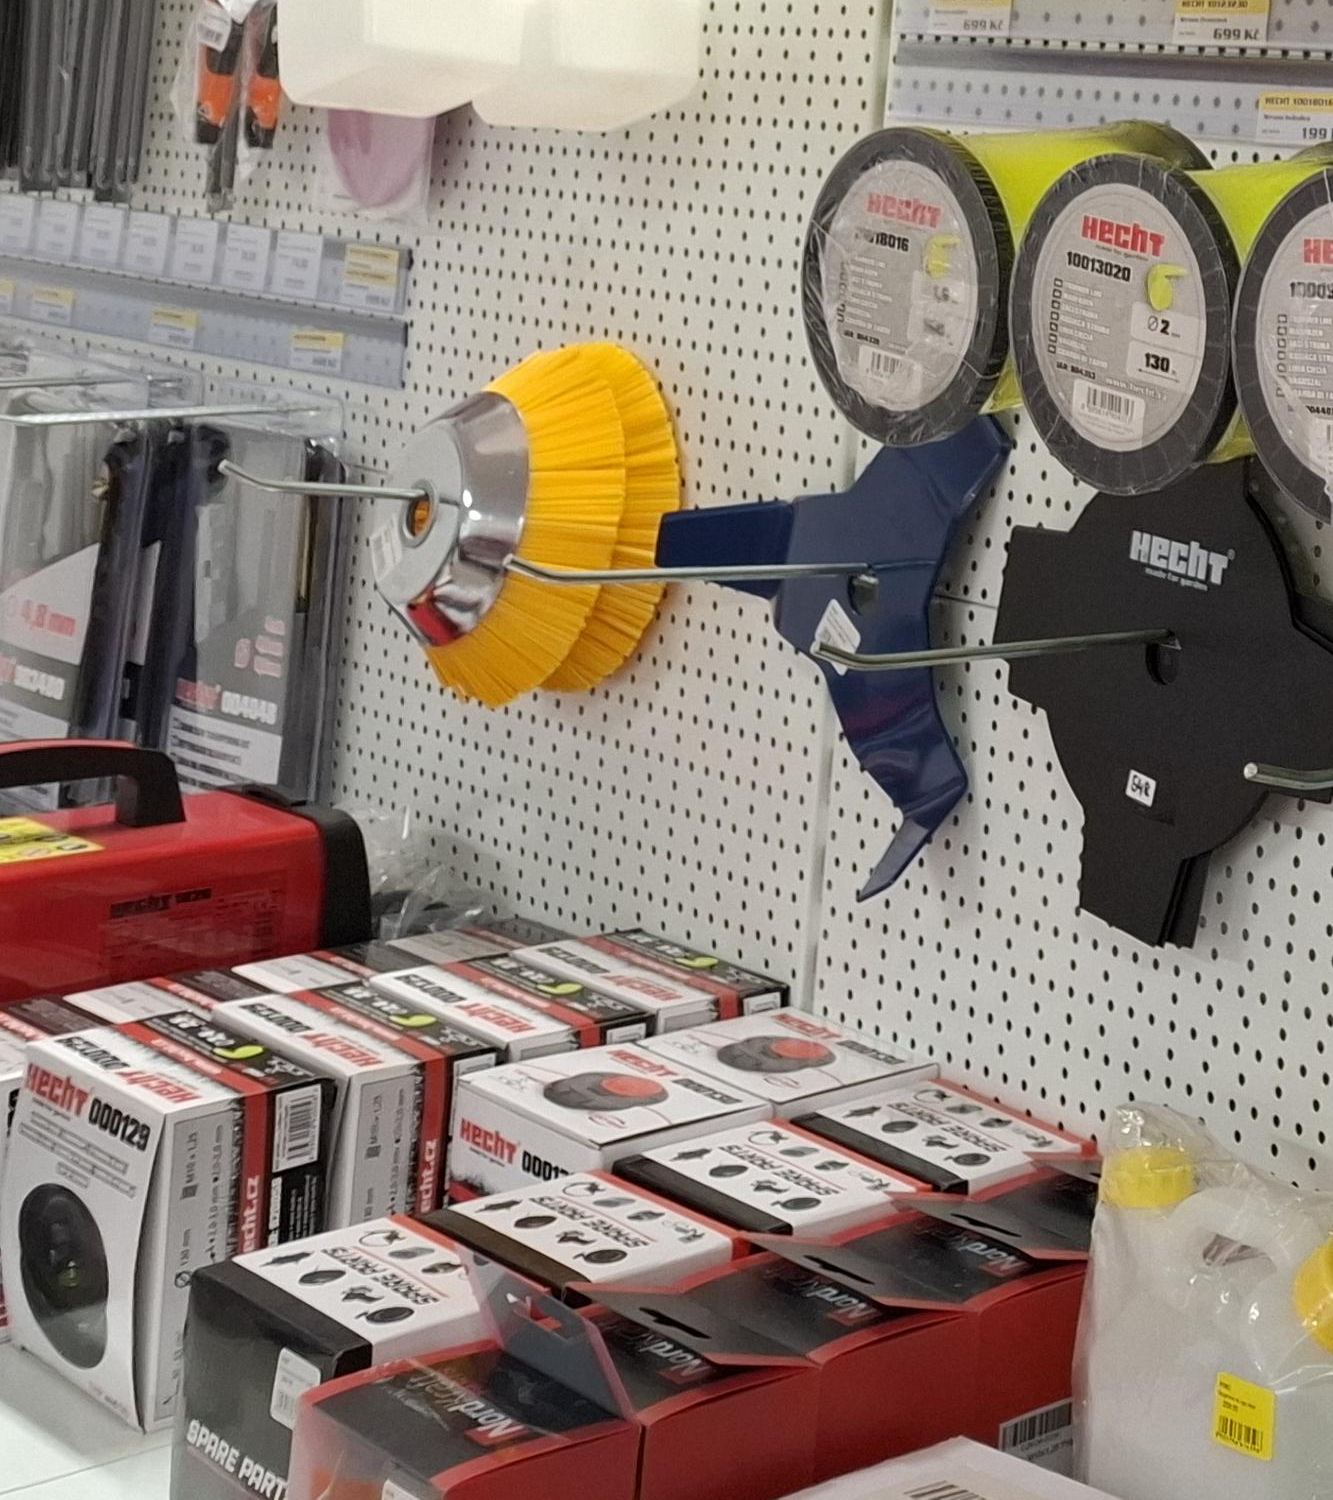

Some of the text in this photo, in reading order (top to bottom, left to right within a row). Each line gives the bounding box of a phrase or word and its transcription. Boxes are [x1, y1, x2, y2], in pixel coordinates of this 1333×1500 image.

[1066, 250, 1131, 283] 10013020
[1144, 351, 1170, 374] 130
[88, 1097, 151, 1152] 000129
[186, 1419, 237, 1476] SPARE
